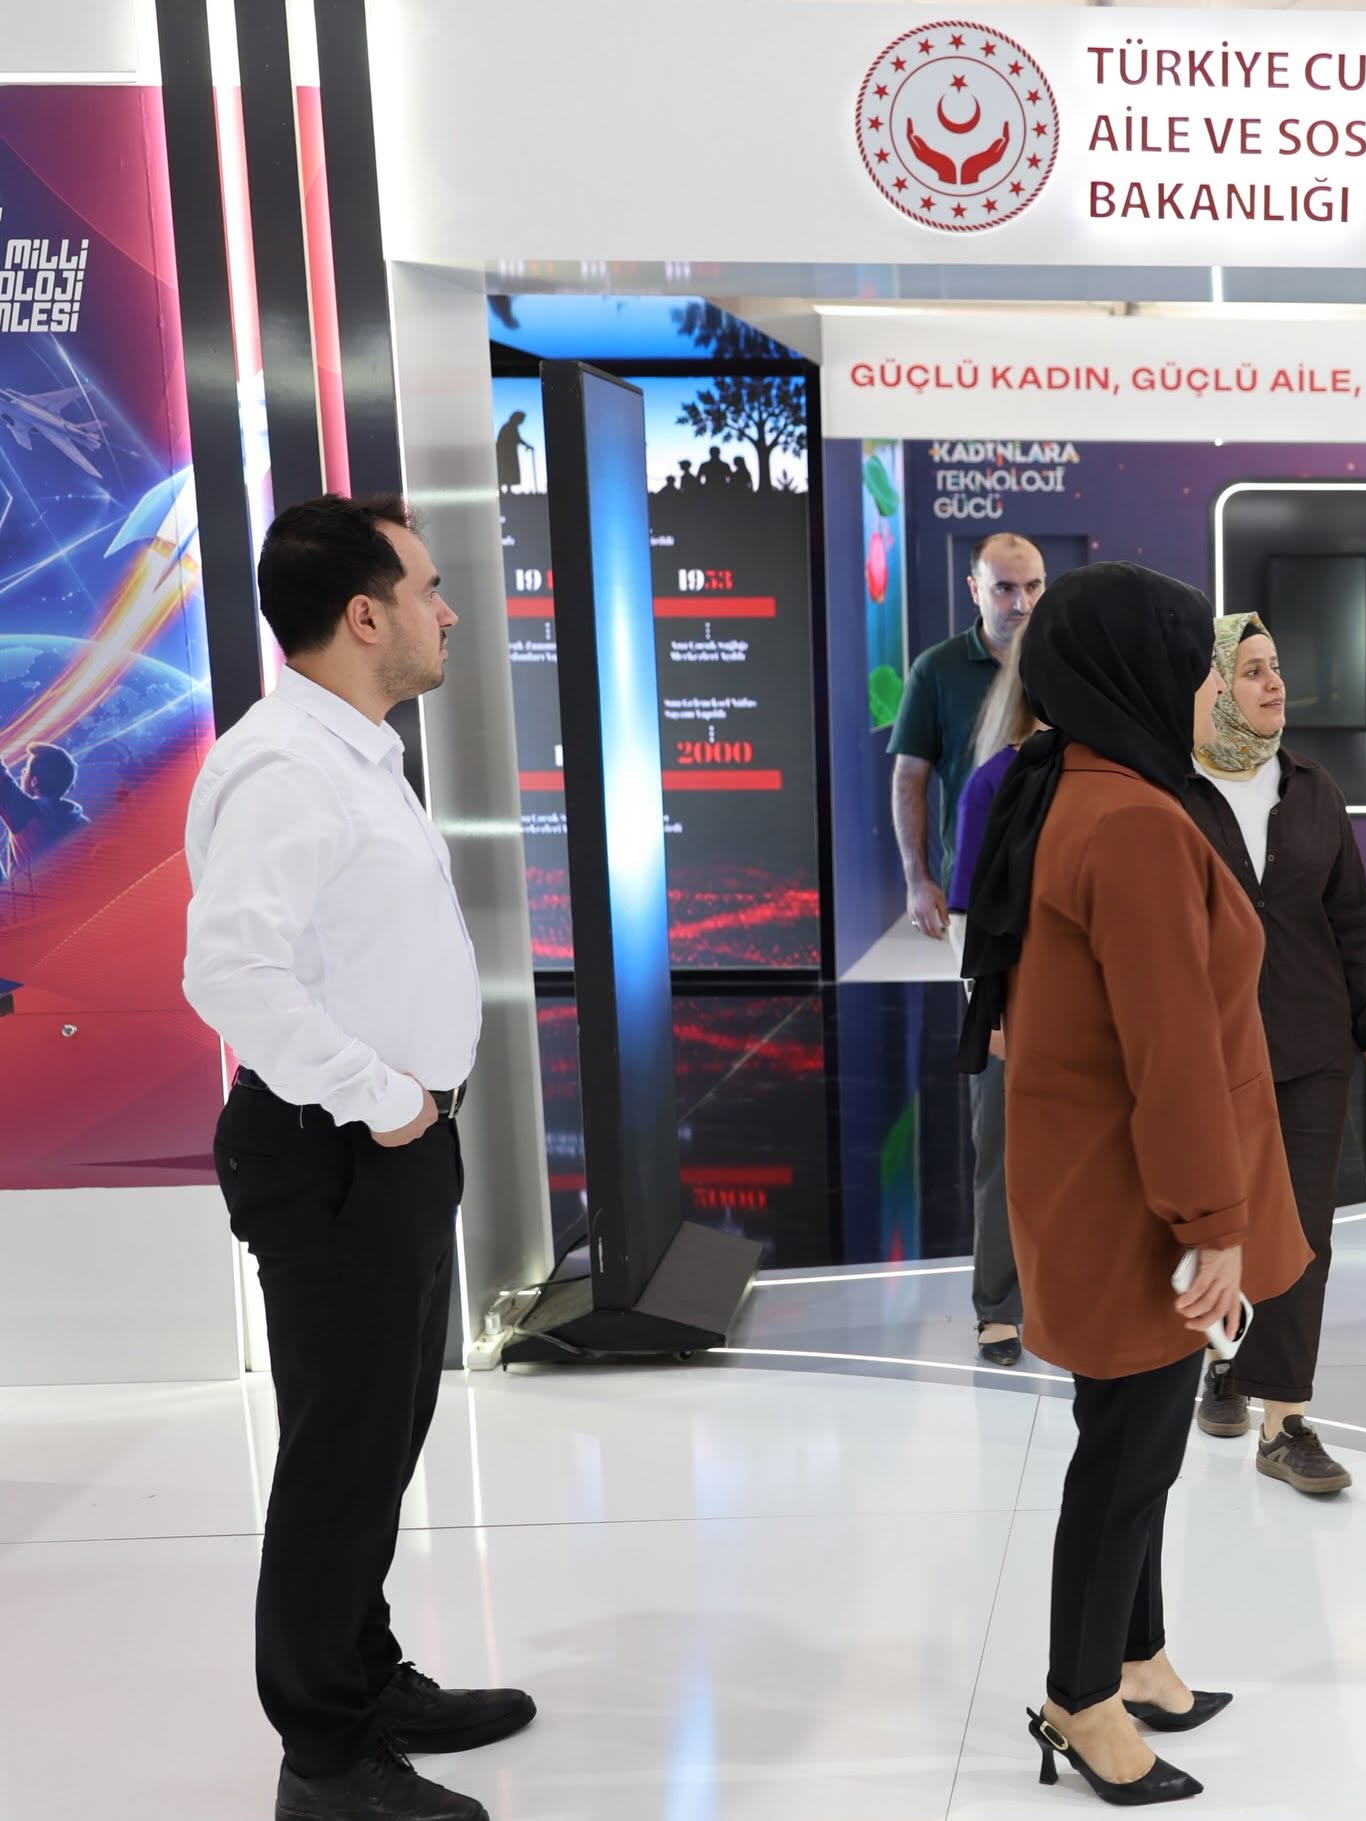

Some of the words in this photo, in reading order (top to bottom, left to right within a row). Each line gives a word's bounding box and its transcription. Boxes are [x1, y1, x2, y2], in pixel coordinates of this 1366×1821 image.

[1087, 38, 1290, 88] TÜRKİYE
[1088, 105, 1190, 153] AİLE
[1203, 117, 1262, 154] VE
[1089, 176, 1349, 222] BAKANLIĞI
[850, 358, 979, 394] GÜÇLÜ
[991, 365, 1119, 396] KADIN,
[1131, 361, 1258, 397] GÜÇLÜ
[1269, 363, 1361, 397] AİLE,
[931, 440, 1080, 464] KADINLARA
[936, 466, 1066, 492] TEKNOLOJİ
[933, 493, 1004, 519] GÜCÜ
[677, 741, 753, 765] 2000
